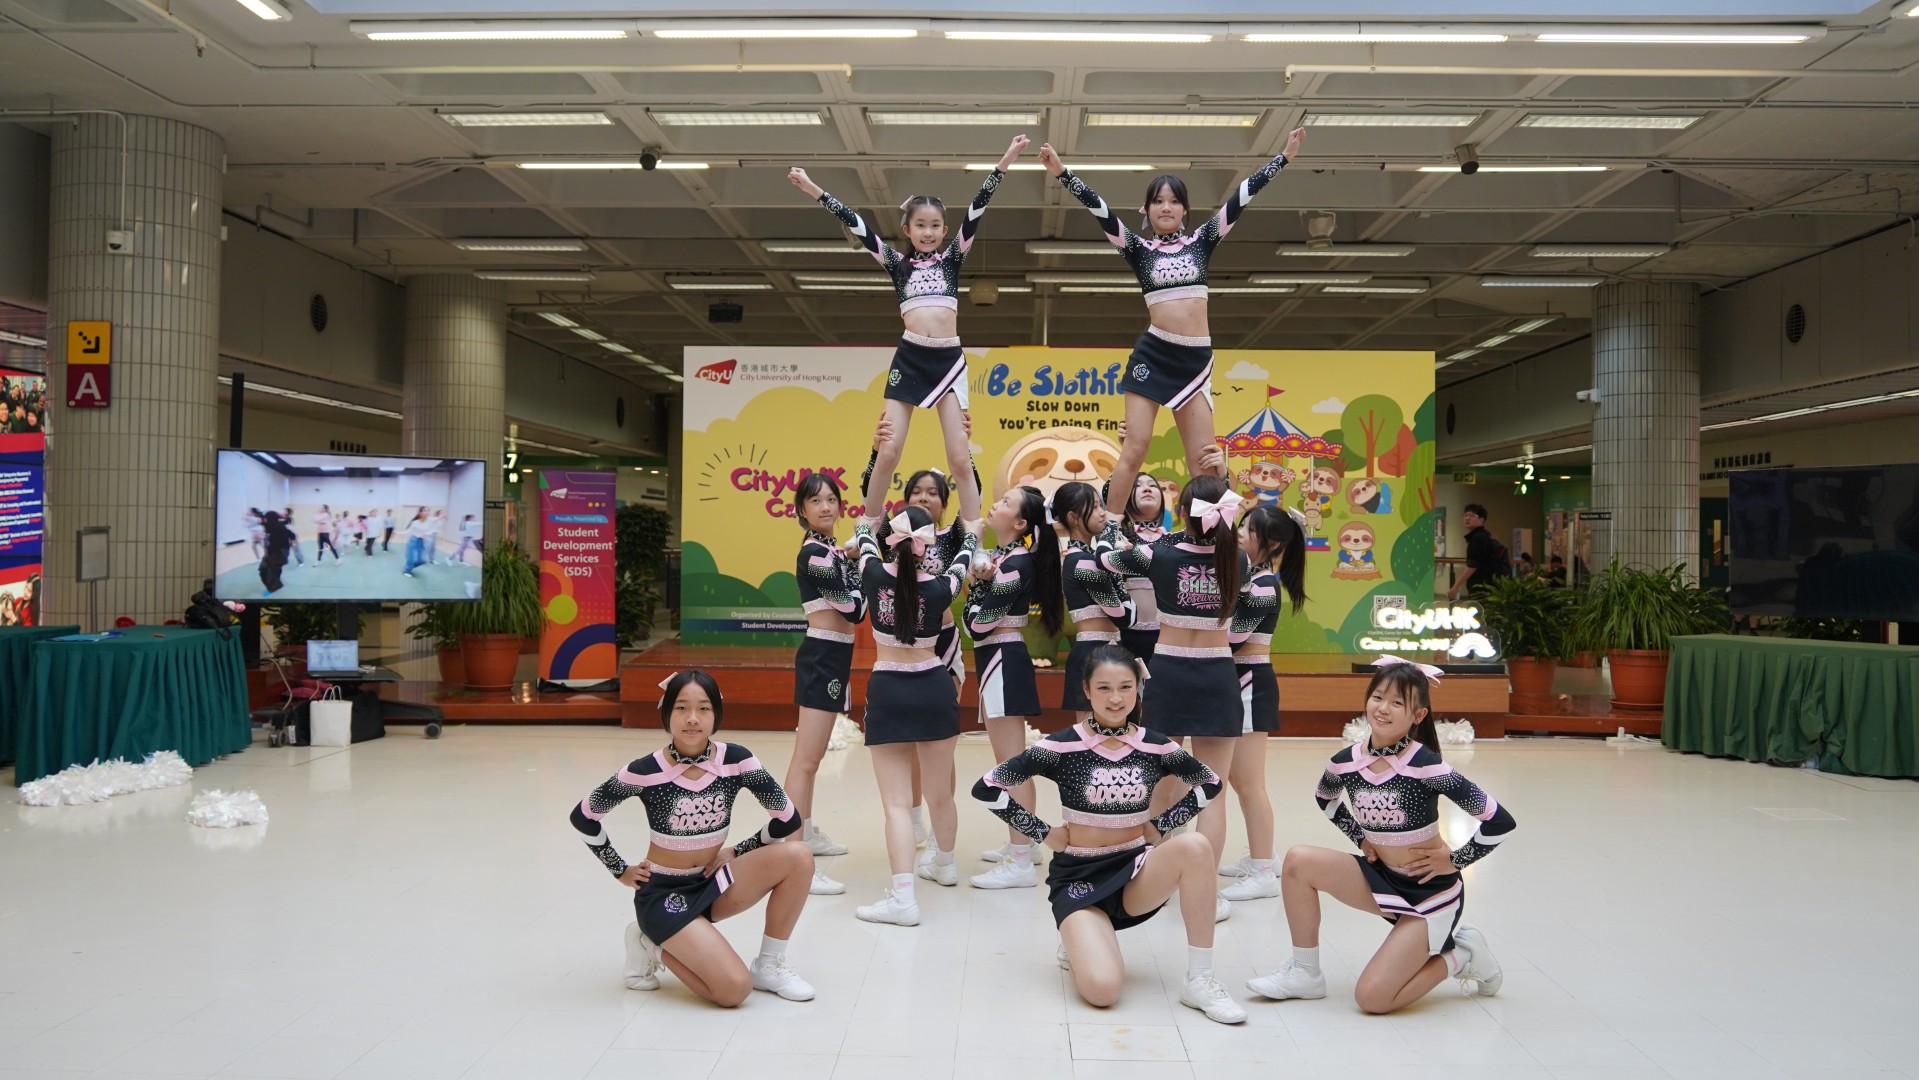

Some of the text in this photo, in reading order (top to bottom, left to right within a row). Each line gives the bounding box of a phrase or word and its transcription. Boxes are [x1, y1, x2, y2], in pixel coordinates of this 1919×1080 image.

[740, 363, 799, 374] 香港城市大學
[700, 368, 733, 382] CityU
[740, 373, 842, 383] City University of Hong Kong
[988, 362, 1125, 397] Be Slothf
[75, 372, 101, 400] A
[999, 417, 1047, 430] You're
[1052, 418, 1092, 430] Doing
[506, 453, 518, 469] 7
[1524, 464, 1535, 480] 2
[557, 527, 599, 537] Student
[543, 540, 613, 552] Development
[557, 553, 599, 563] Services
[564, 566, 593, 577] (SDS)
[730, 611, 762, 619] Organised
[763, 611, 770, 619] by
[1376, 606, 1481, 634] CityUHK
[767, 622, 808, 630] Development
